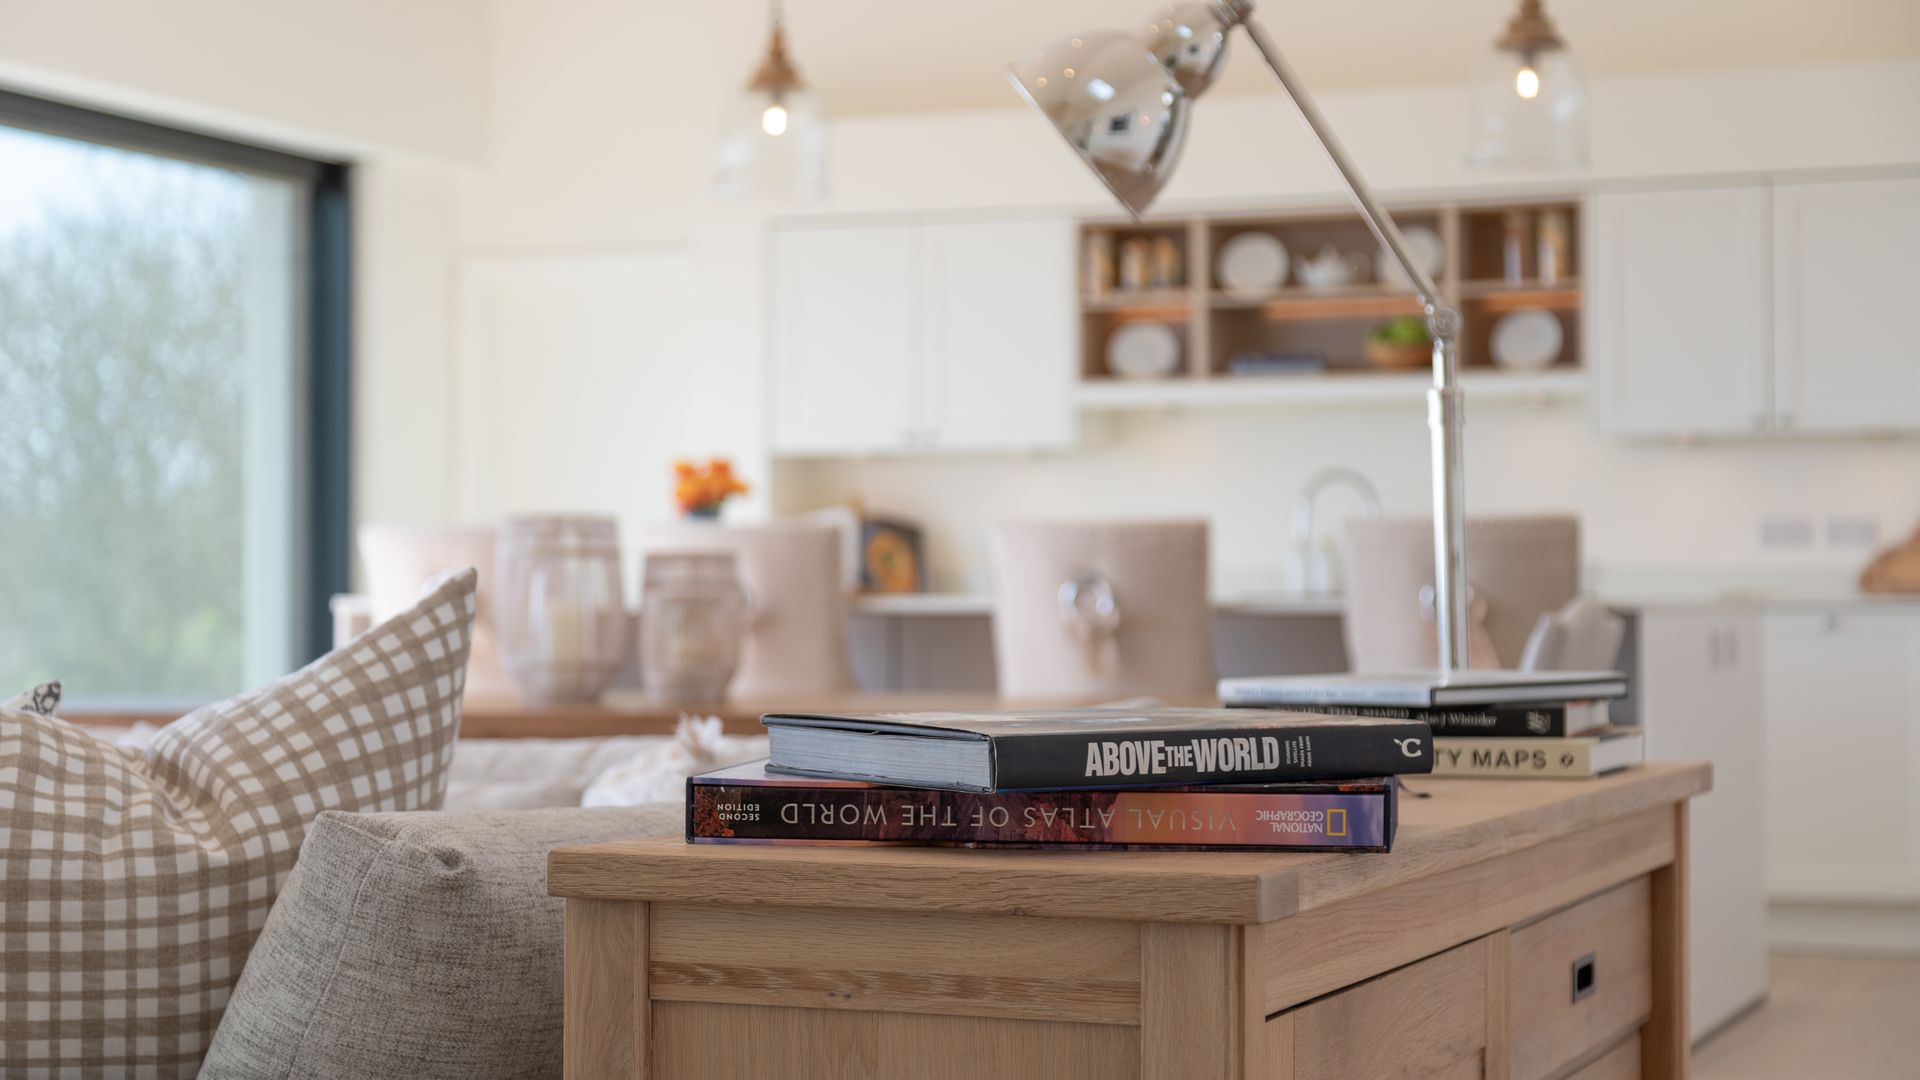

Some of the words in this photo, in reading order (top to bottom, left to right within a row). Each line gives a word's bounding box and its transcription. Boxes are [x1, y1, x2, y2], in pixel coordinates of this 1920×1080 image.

[1085, 740, 1166, 777] ABOVE
[1165, 745, 1193, 768] THE
[1191, 736, 1280, 773] WORLD
[1432, 750, 1463, 768] TY
[1472, 750, 1547, 770] MAPS
[717, 803, 760, 812] EDITION
[718, 812, 760, 821] SECOND
[780, 803, 887, 826] WORLD
[901, 805, 957, 826] THE
[970, 806, 1009, 828] OF
[1024, 806, 1115, 829] ATLAS
[1255, 809, 1324, 822] GEOGRAPHIC
[1129, 807, 1237, 831] VISUAL
[1271, 822, 1324, 834] NATIONAL
